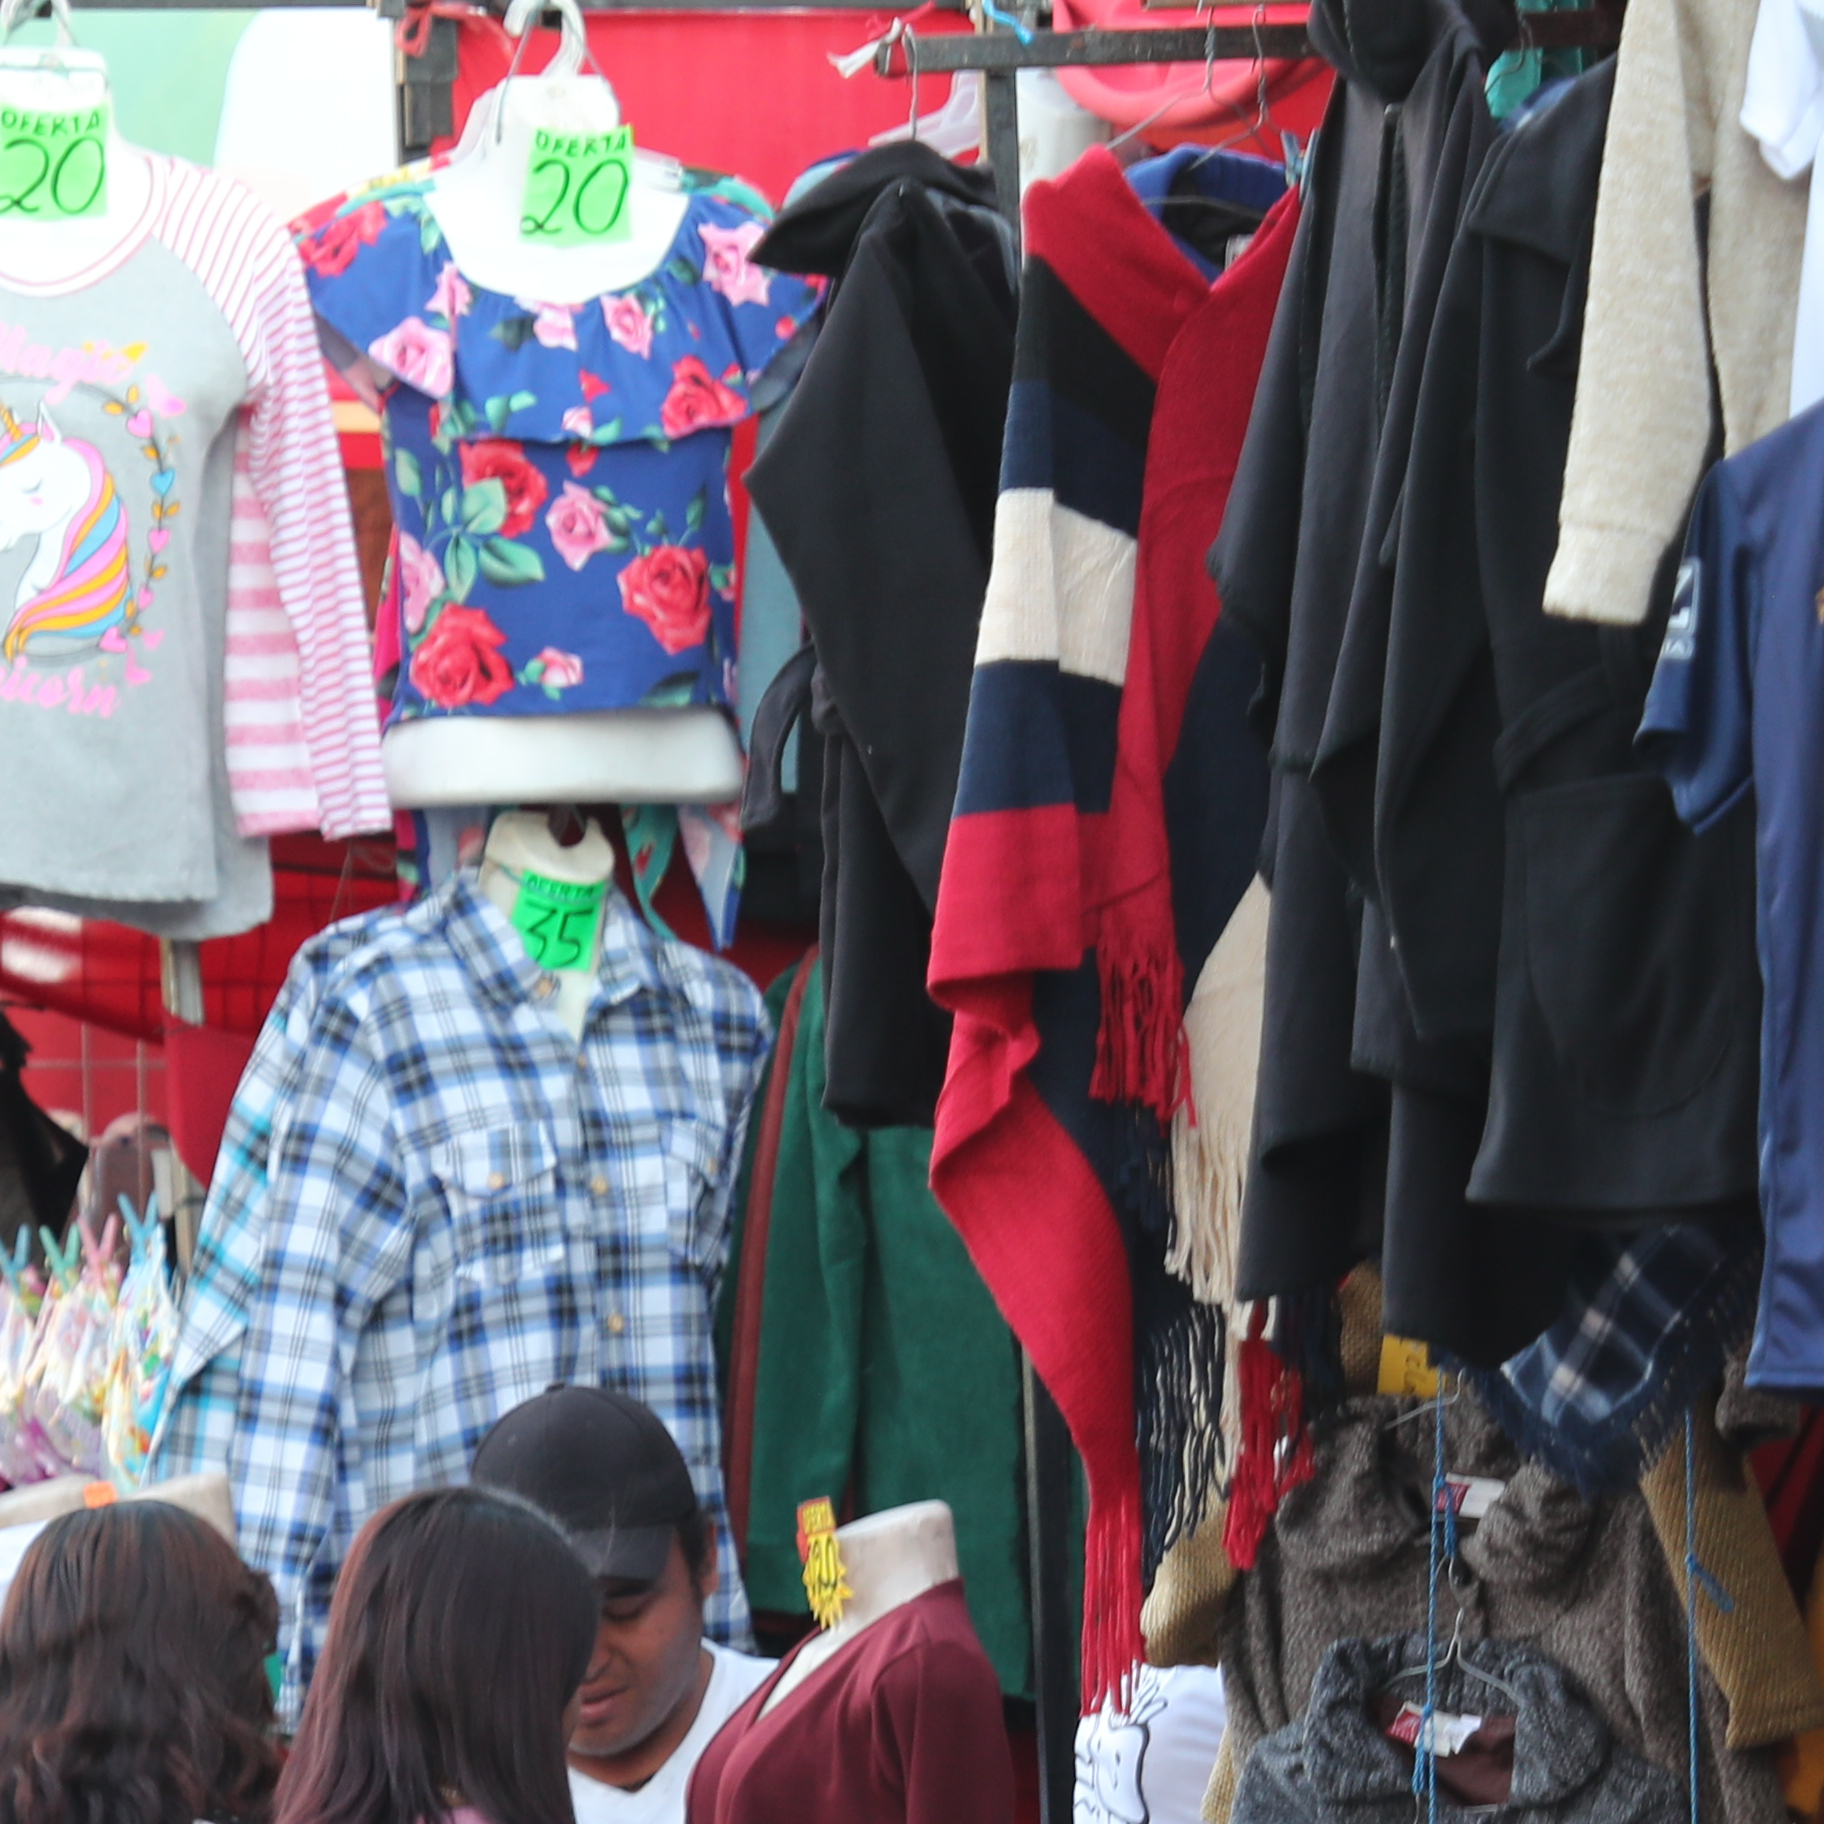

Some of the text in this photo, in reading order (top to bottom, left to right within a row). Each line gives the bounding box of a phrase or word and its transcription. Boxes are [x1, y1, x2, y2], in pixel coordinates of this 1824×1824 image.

[0, 110, 101, 138] OFERTA
[519, 158, 629, 236] 20
[522, 898, 595, 969] 35
